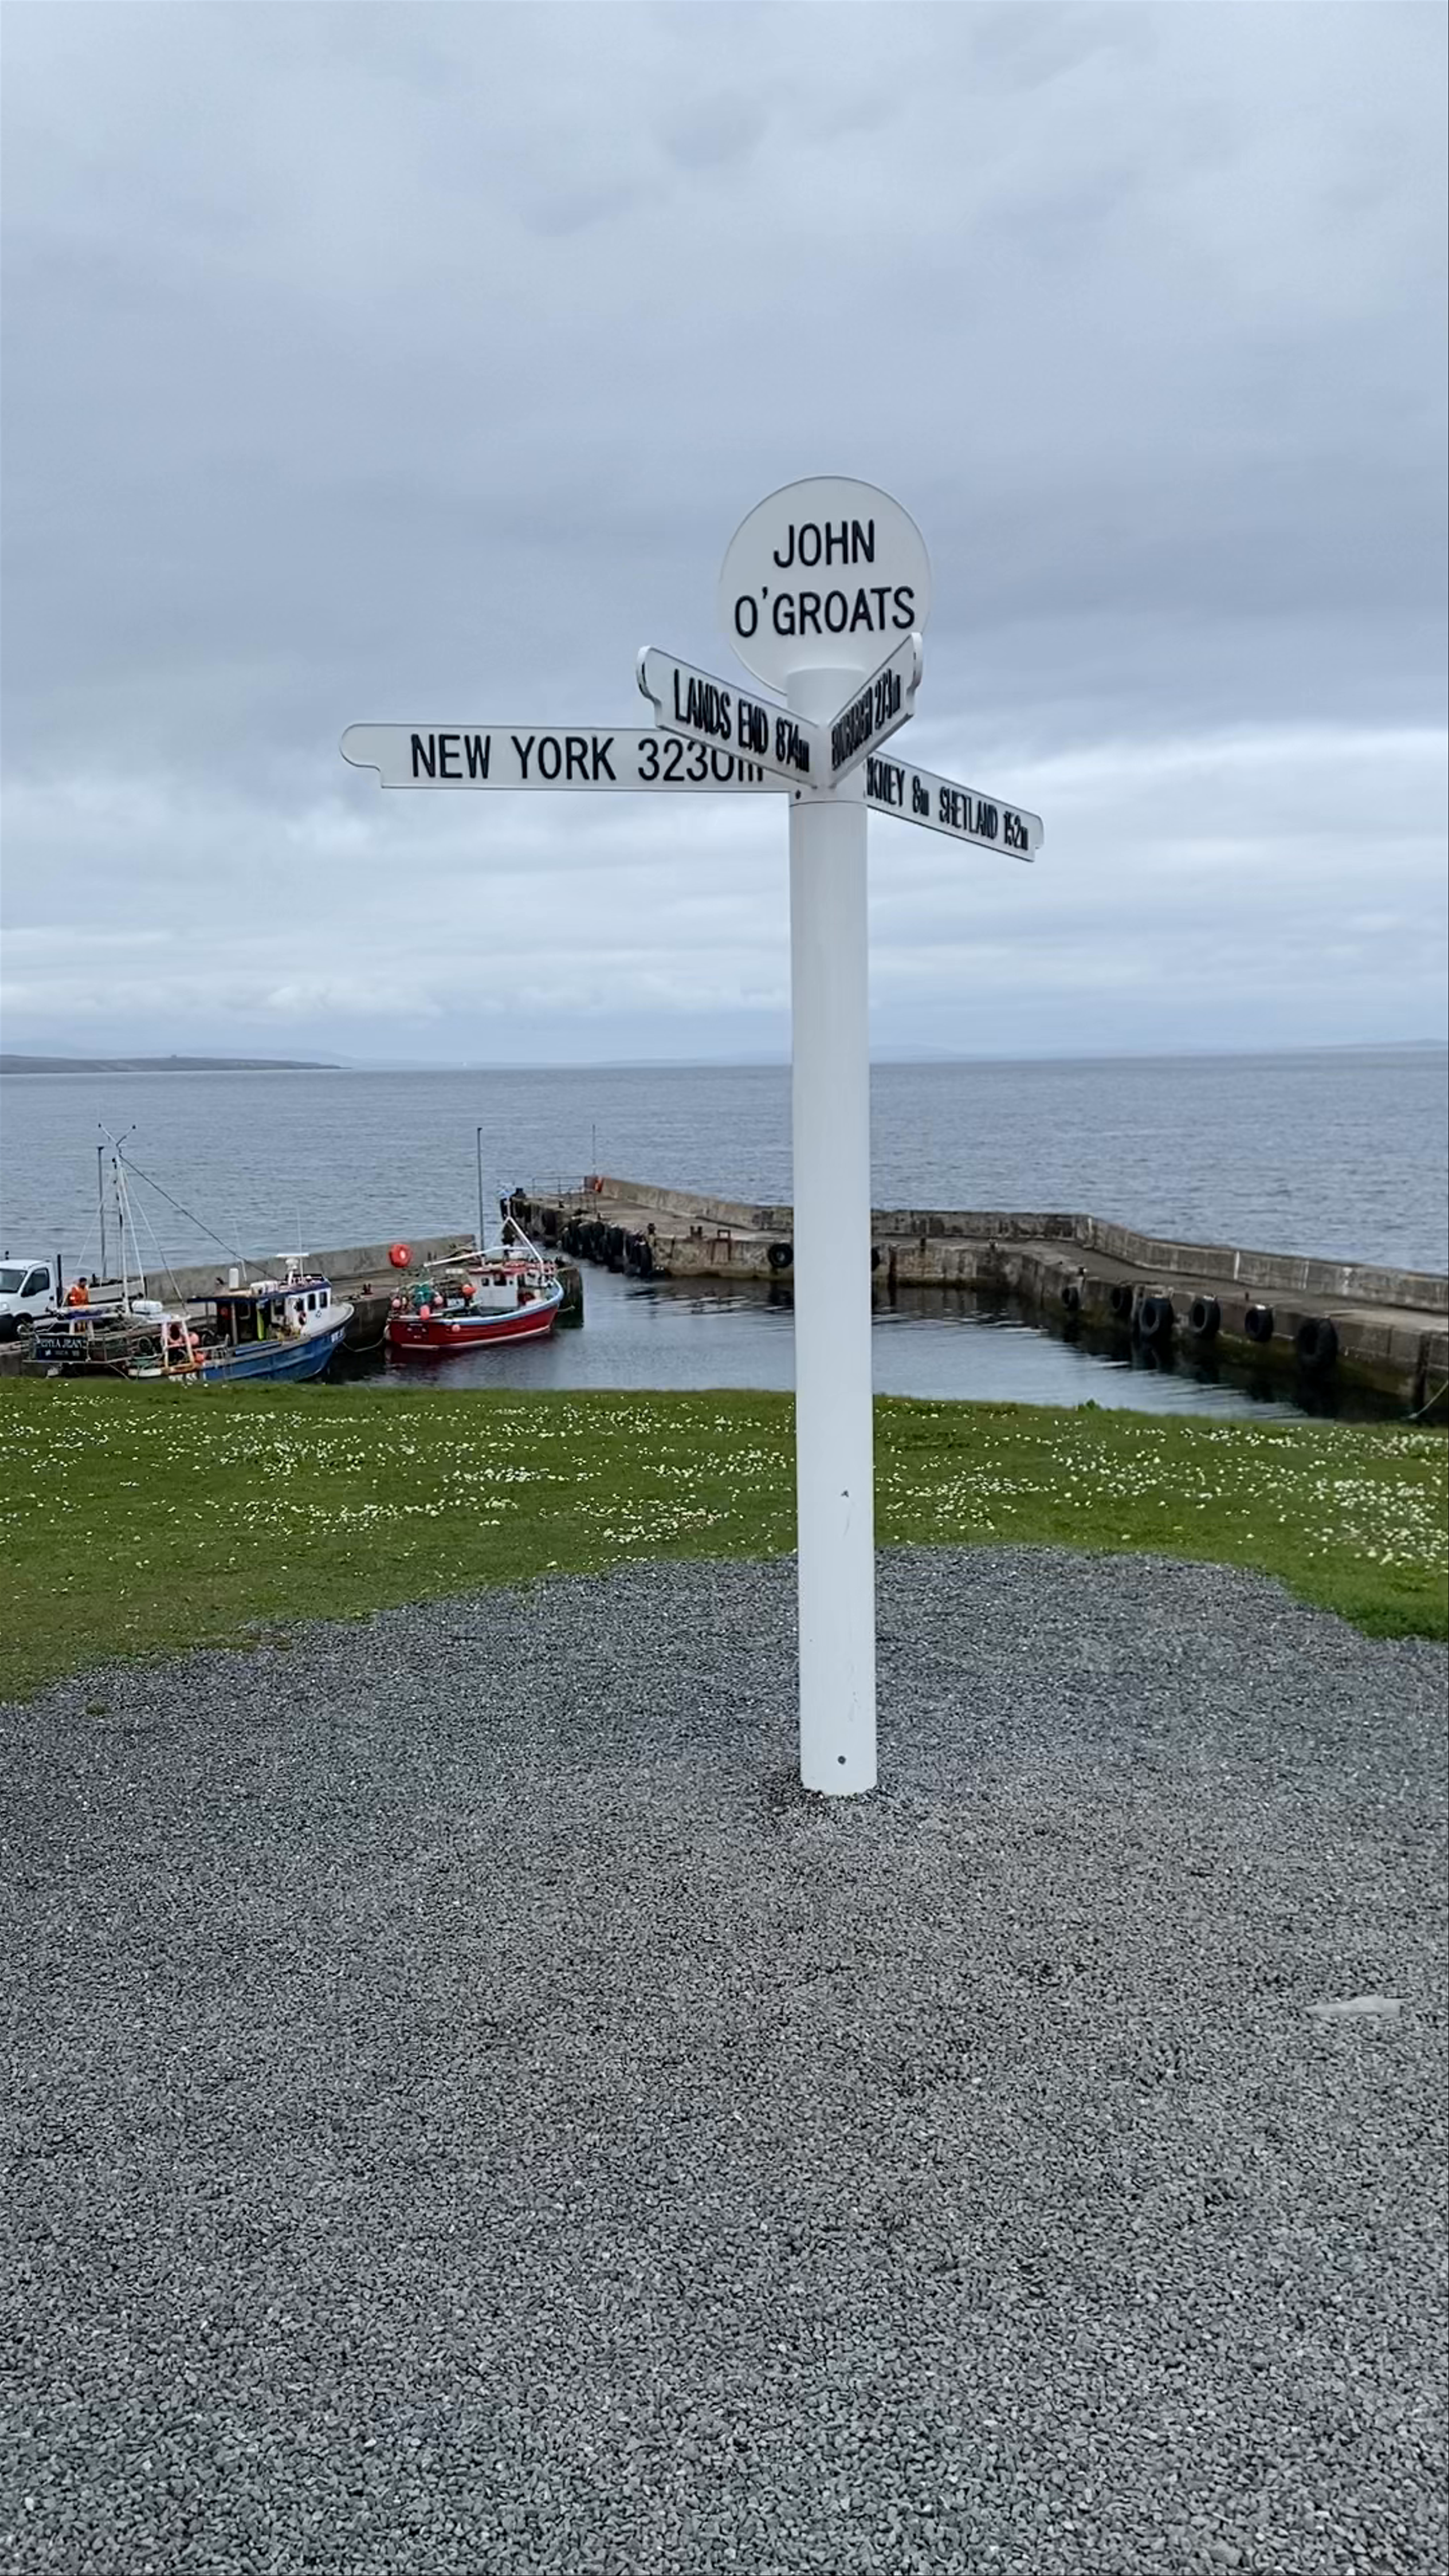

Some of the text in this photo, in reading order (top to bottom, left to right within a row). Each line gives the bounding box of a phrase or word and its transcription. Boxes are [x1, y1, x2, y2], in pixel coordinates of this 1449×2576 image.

[773, 519, 875, 569] JOHN
[734, 586, 915, 638] O'GROATS
[673, 668, 811, 773] LANDS END 874m
[411, 734, 763, 783] NEW YORK 3230m
[912, 775, 929, 817] 8m
[939, 786, 998, 840] SHETLAND
[1003, 810, 1028, 850] 152m
